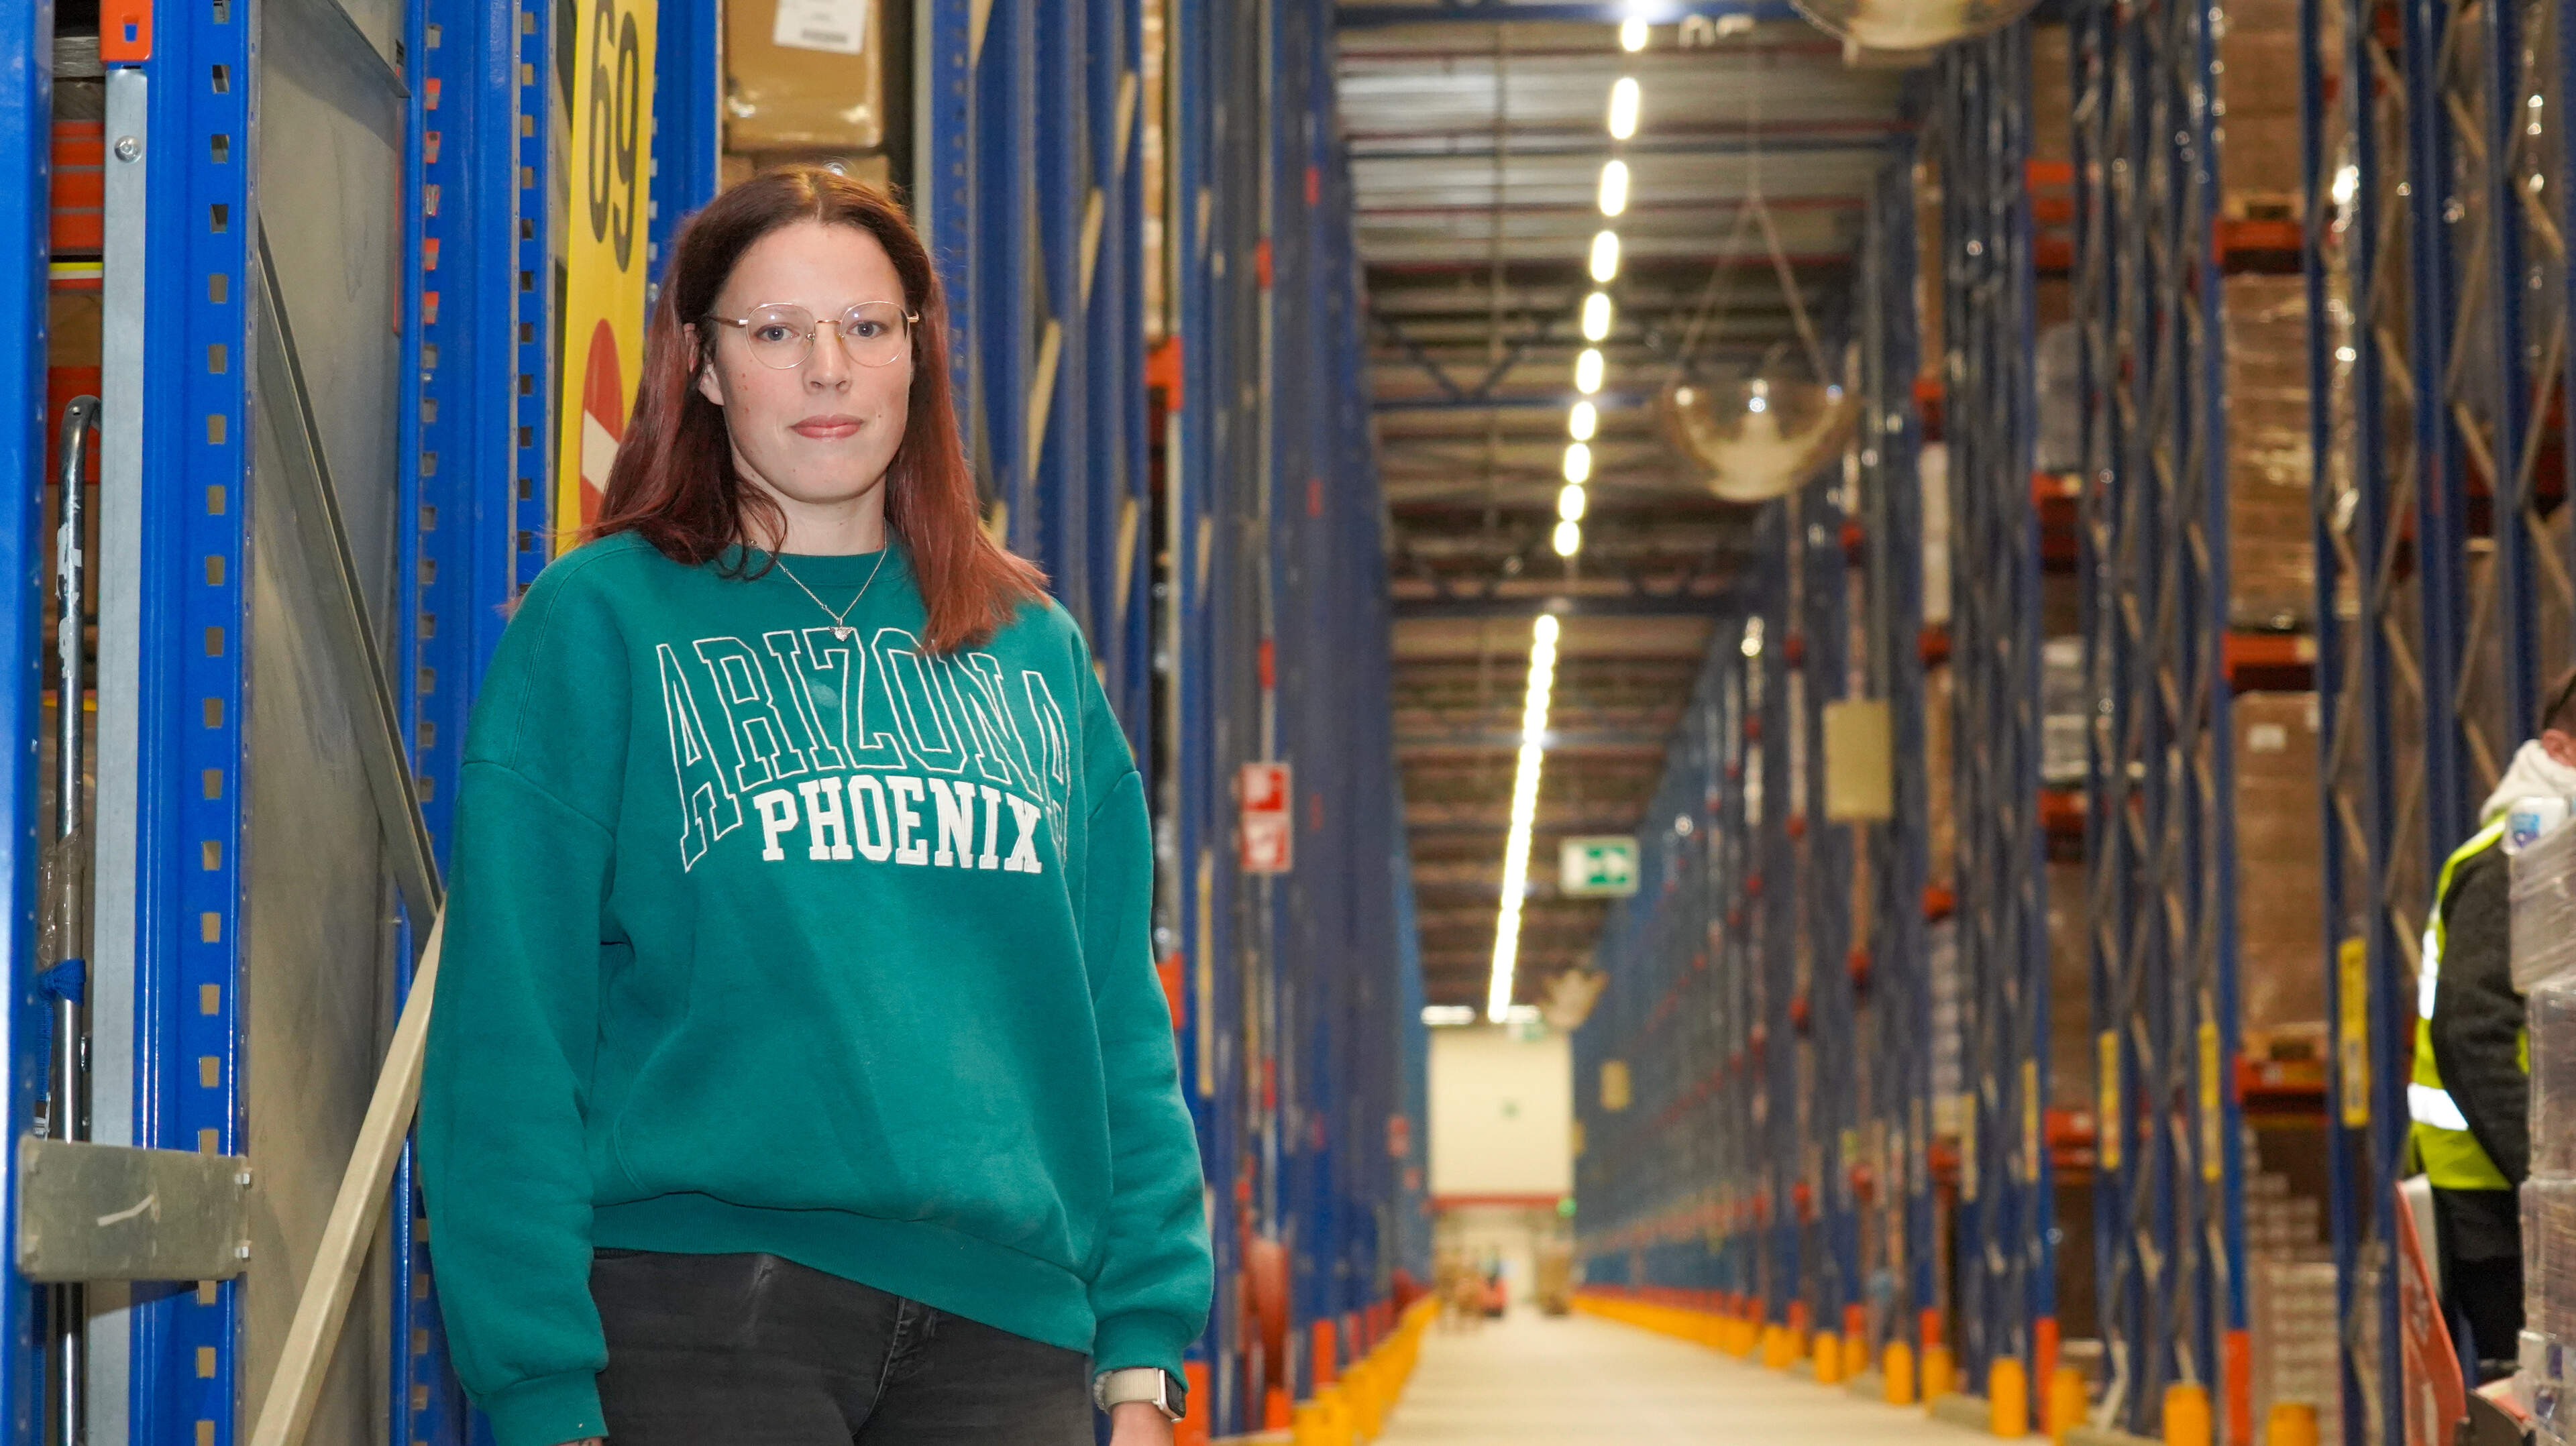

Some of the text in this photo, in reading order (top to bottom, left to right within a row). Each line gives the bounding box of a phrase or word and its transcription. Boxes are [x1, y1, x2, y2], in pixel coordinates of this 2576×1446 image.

[588, 0, 639, 272] 69
[655, 626, 1071, 873] ARIZONA
[752, 774, 1042, 874] PHOENIX
